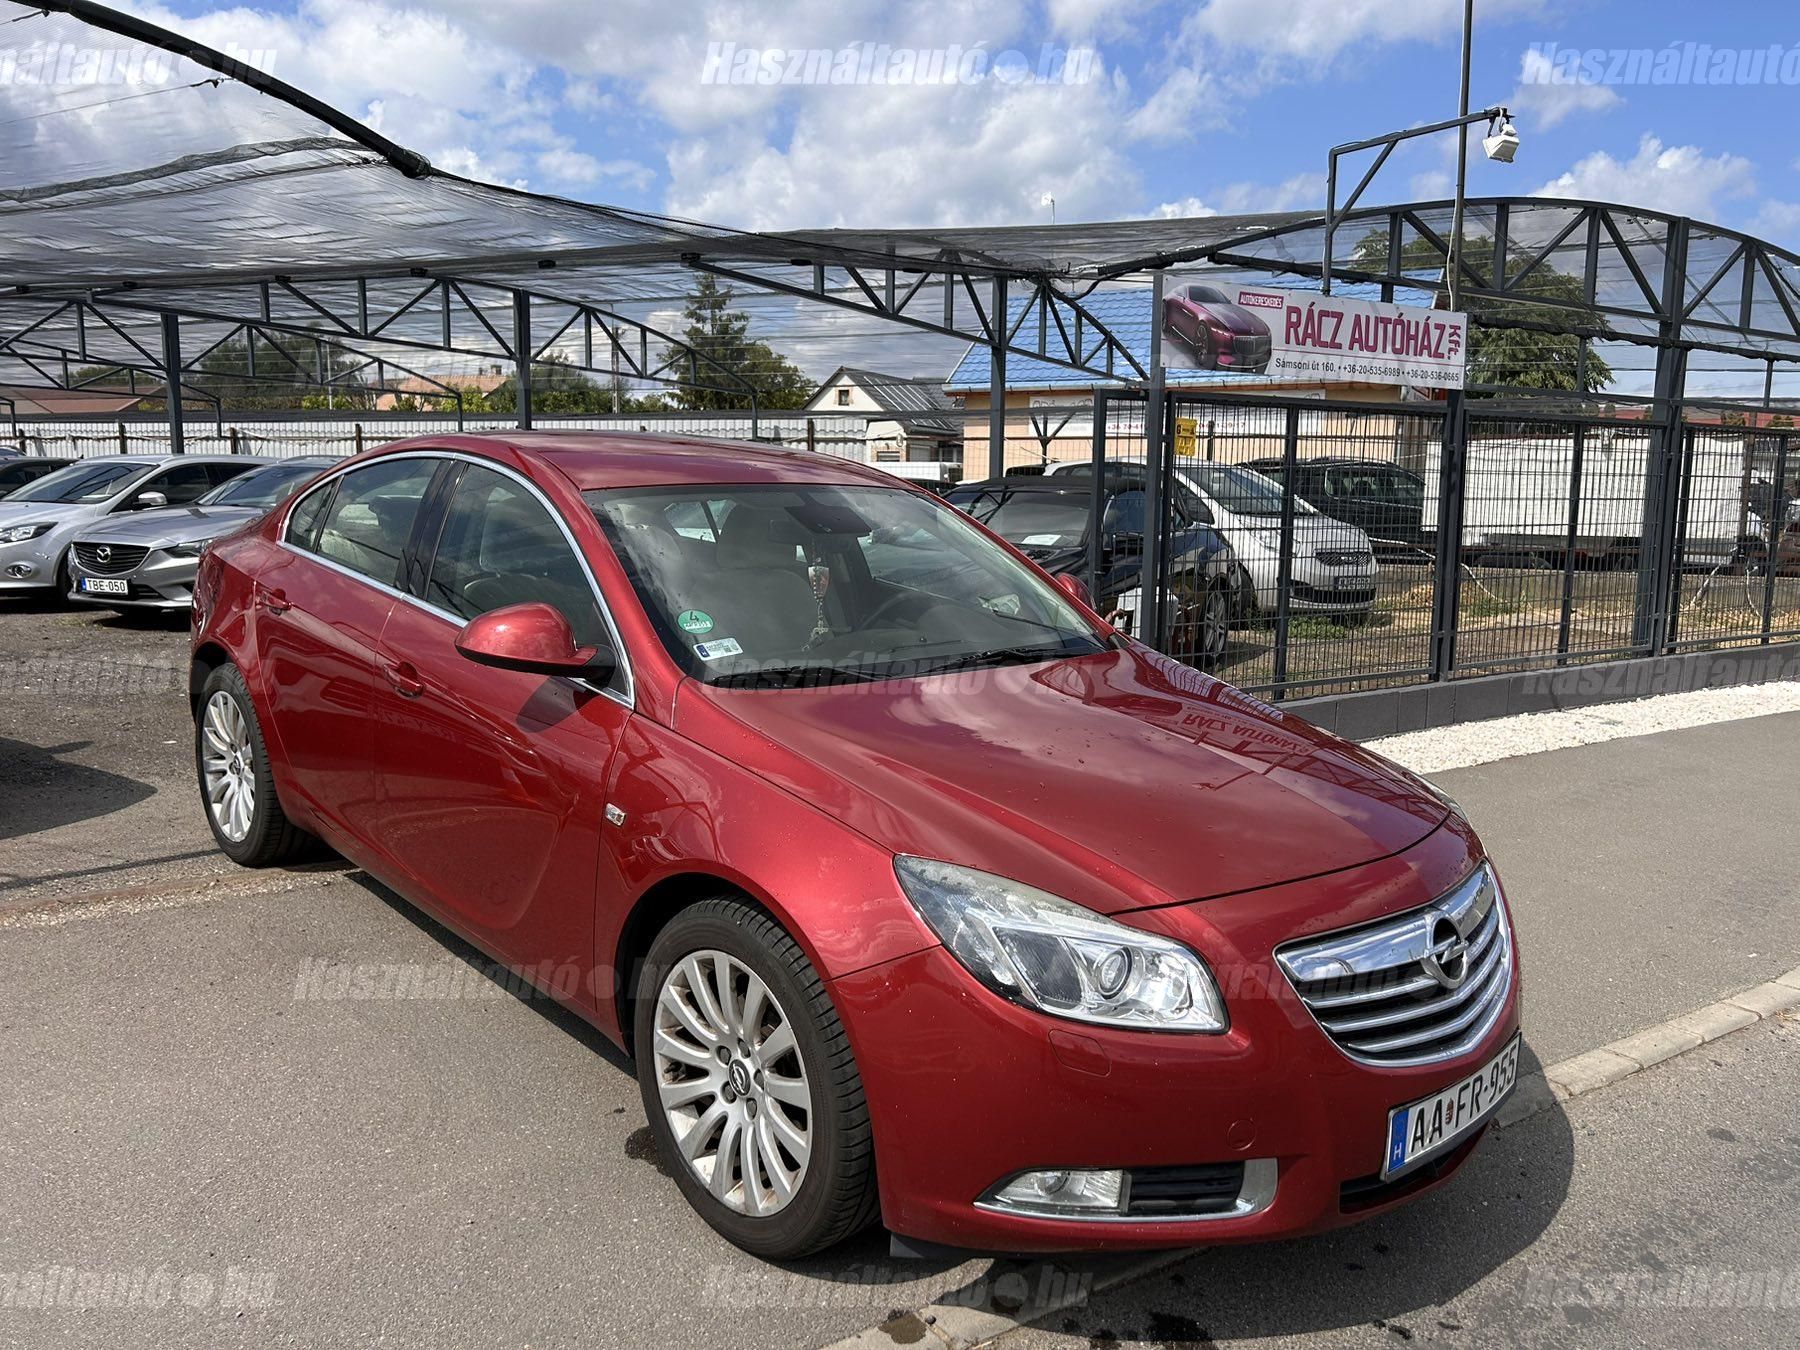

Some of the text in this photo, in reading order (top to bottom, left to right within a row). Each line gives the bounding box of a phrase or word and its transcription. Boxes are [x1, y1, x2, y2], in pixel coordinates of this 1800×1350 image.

[1240, 293, 1282, 308] AUTÓKERESKEDÉS
[1284, 302, 1446, 359] RÁCZ AUTÓHÁZ
[1275, 357, 1309, 370] Sámsoni
[1312, 361, 1319, 371] út
[1322, 362, 1336, 373] 160.
[1343, 363, 1400, 377] +36-20-535-6989
[1411, 1043, 1517, 1153] AA FR-955
[1393, 1142, 1403, 1161] H
